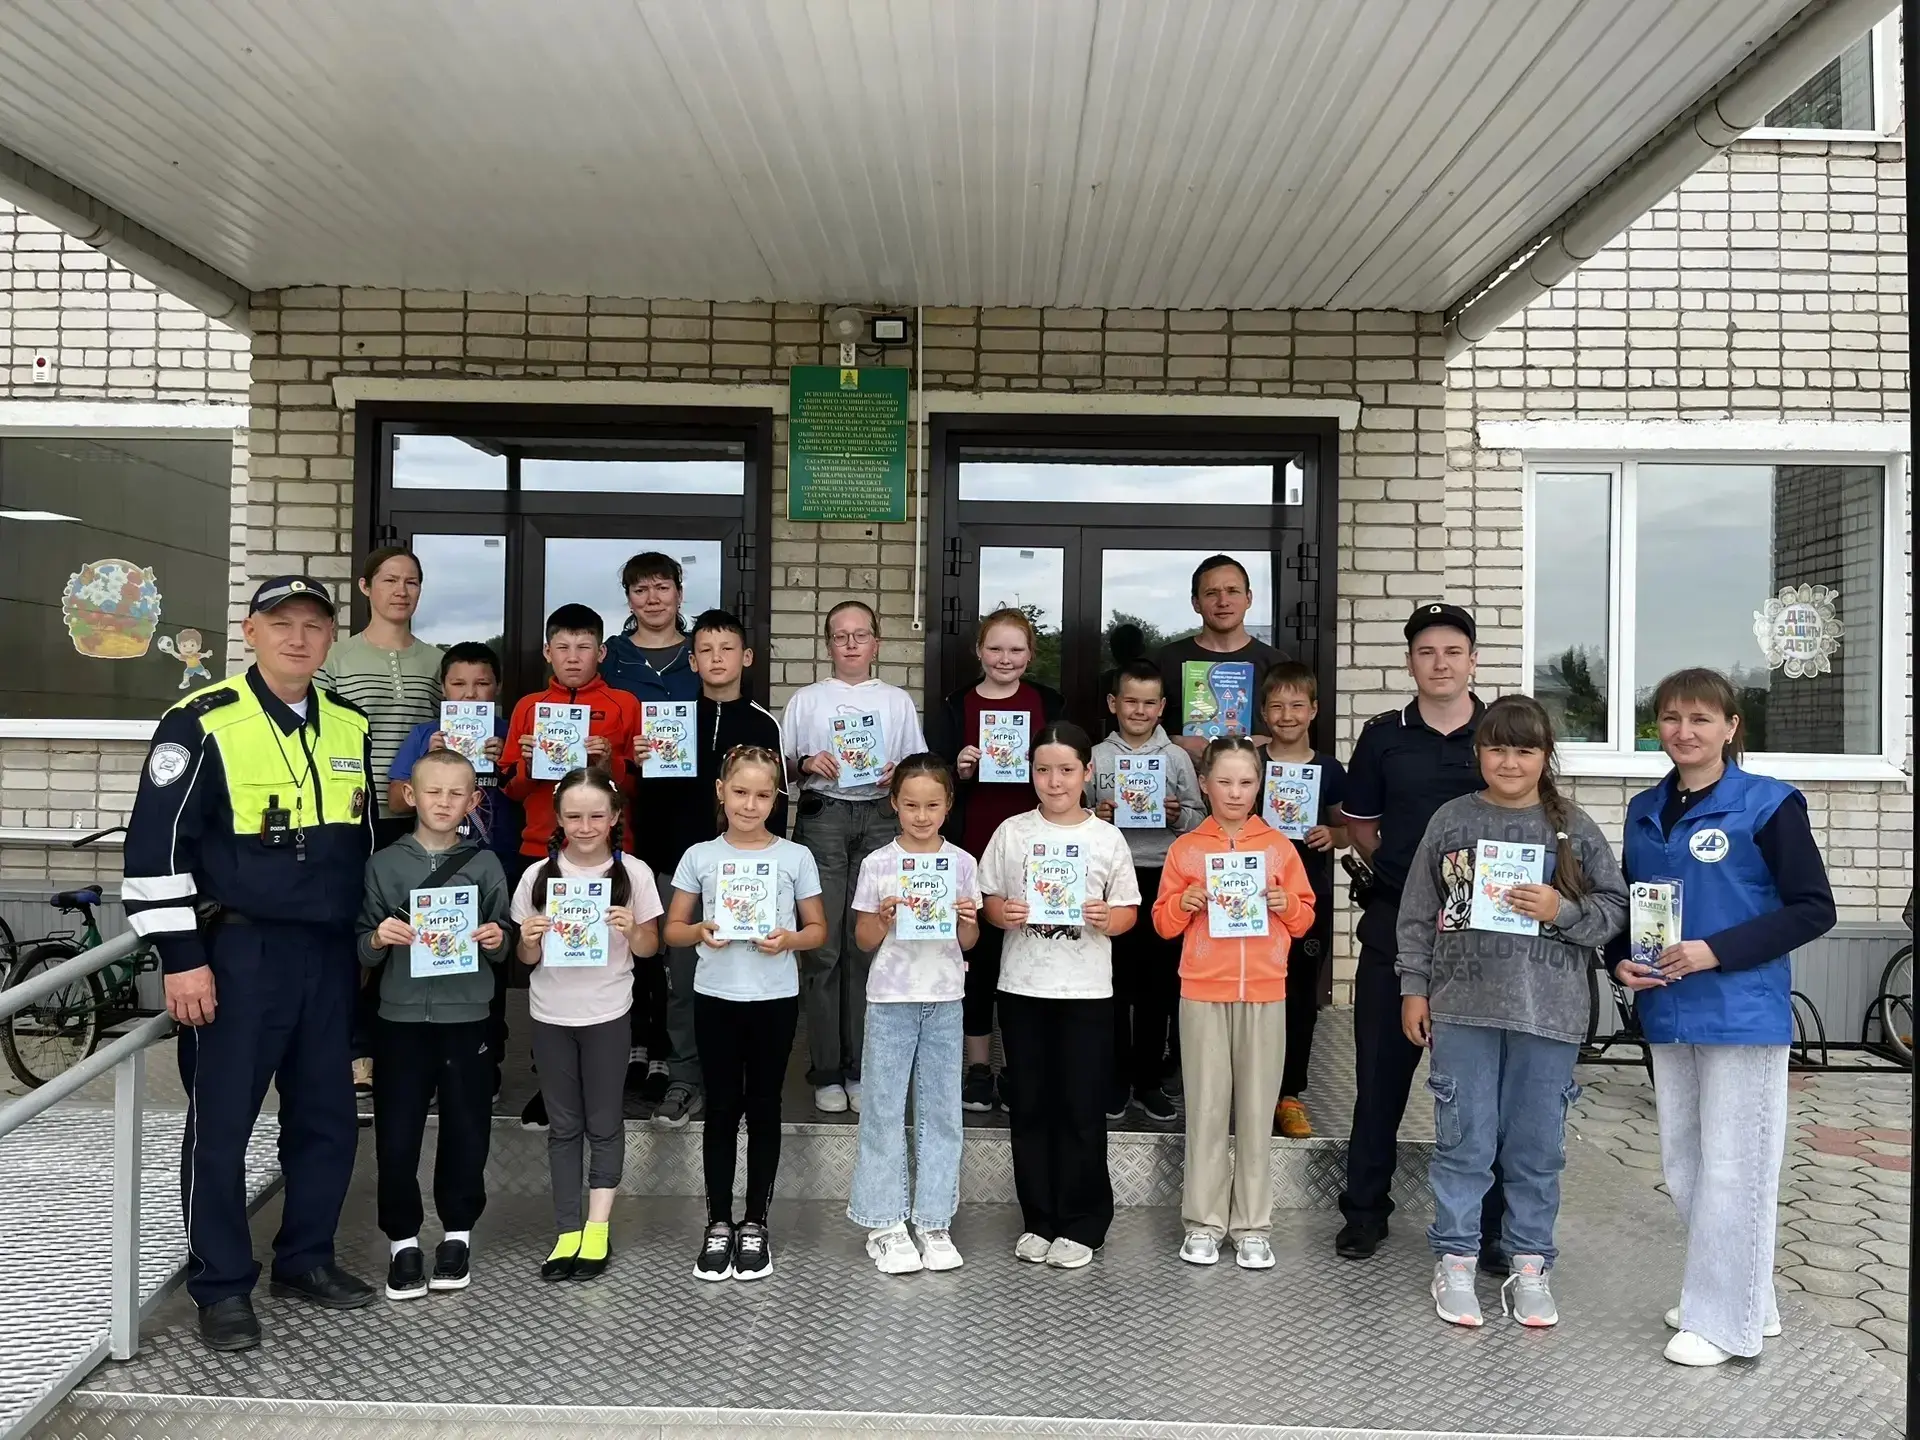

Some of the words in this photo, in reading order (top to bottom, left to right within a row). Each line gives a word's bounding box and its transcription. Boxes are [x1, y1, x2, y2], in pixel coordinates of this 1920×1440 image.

[1785, 610, 1816, 624] ДЕНЬ
[1778, 625, 1820, 638] ЗАЩИТЫ
[1784, 639, 1818, 652] ДЕТЕЙ
[846, 736, 868, 744] ИГРЫ
[1494, 871, 1523, 879] ИГРЫ
[1638, 901, 1666, 911] ПАМЯТКА
[430, 916, 458, 925] ИГРЫ
